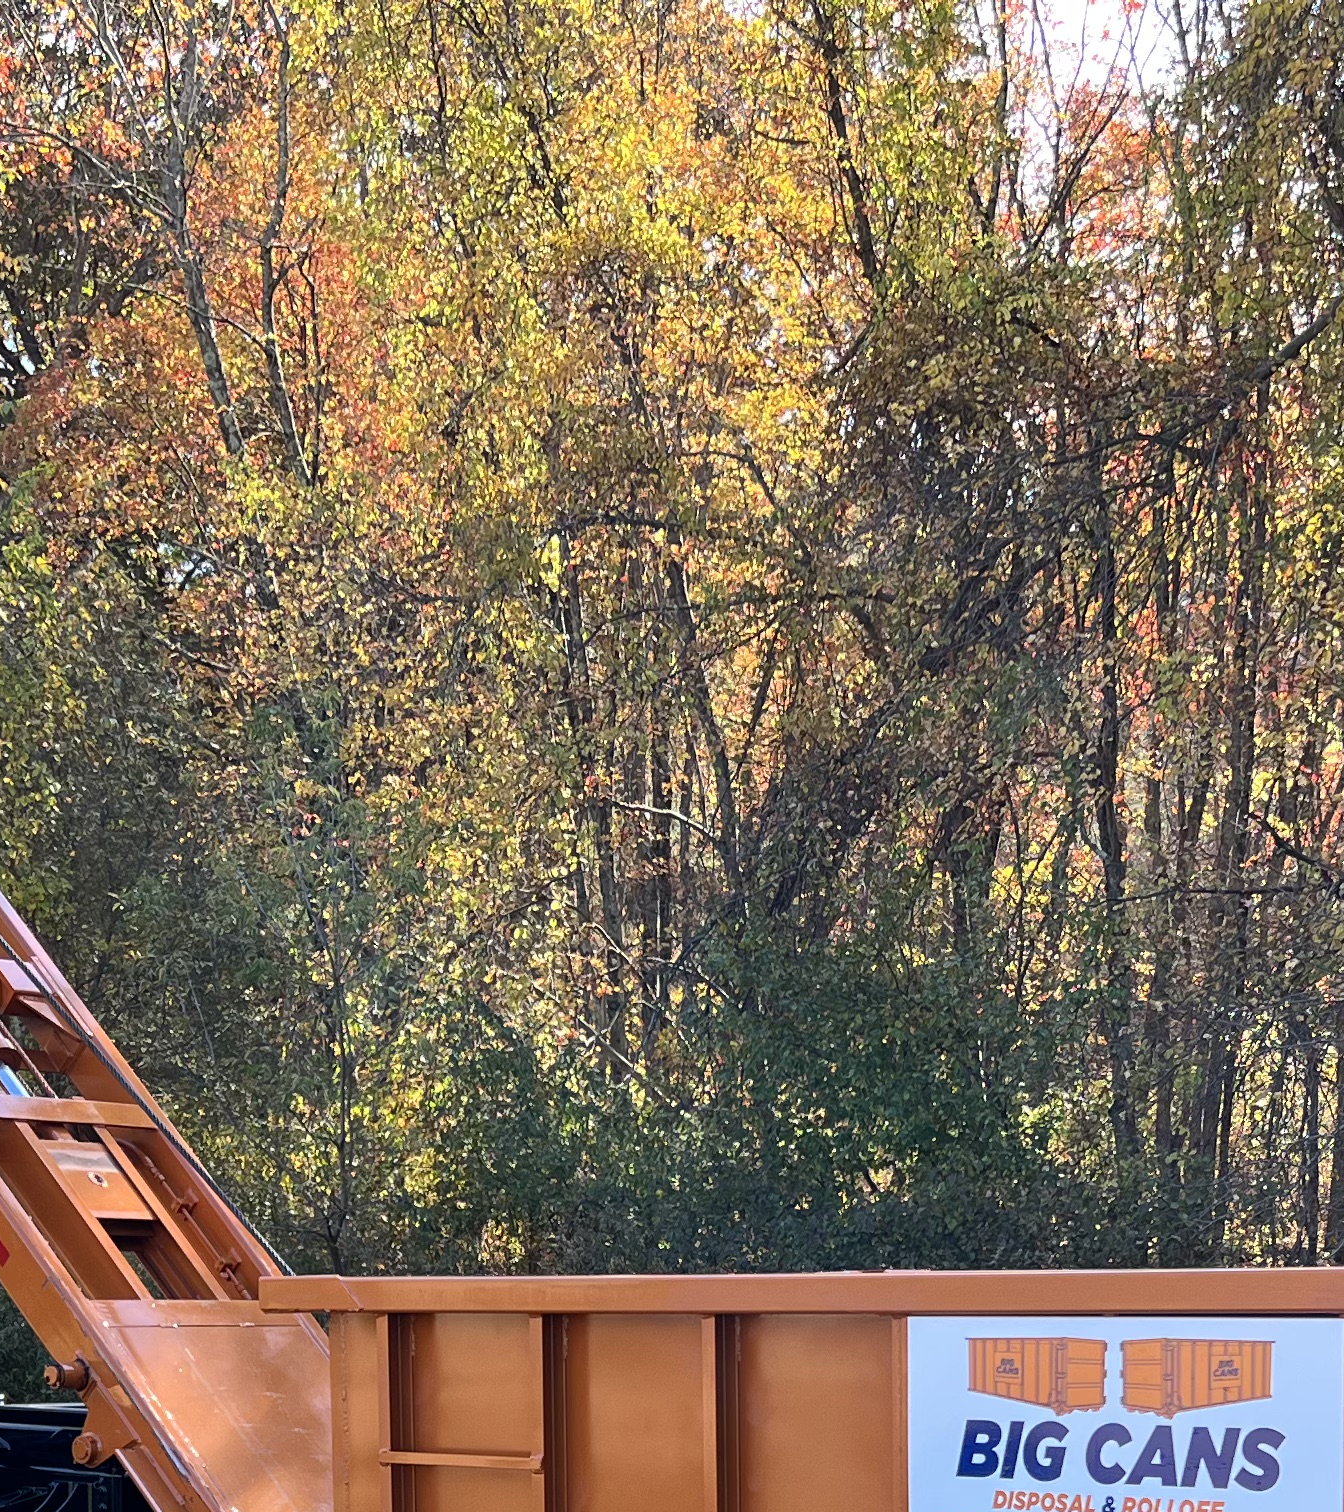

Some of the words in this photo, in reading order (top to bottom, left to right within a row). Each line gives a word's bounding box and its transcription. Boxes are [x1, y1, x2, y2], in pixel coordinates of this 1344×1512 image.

[1000, 1358, 1015, 1368] BIG
[1219, 1360, 1235, 1369] BIG
[996, 1366, 1019, 1376] CANS
[956, 1419, 1069, 1481] BIG
[1085, 1422, 1286, 1492] CANS
